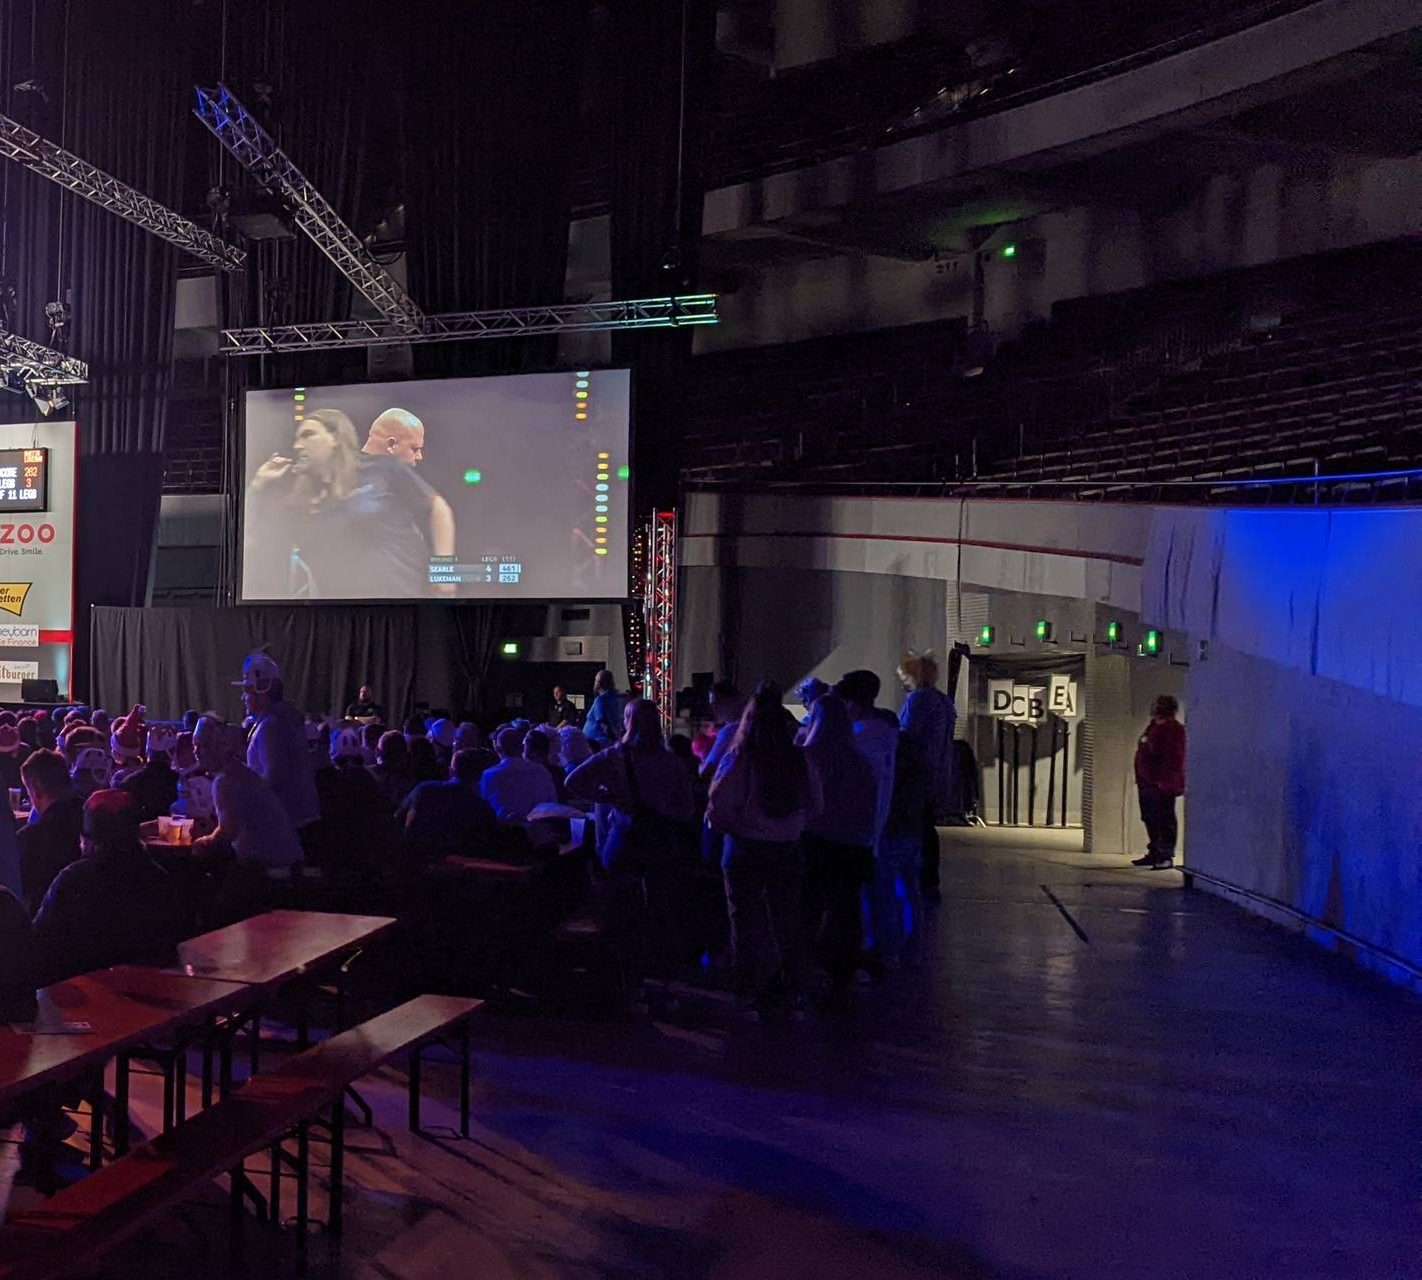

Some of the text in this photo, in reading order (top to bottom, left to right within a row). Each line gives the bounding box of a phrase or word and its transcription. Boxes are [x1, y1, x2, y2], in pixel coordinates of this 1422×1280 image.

[24, 467, 37, 477] 262
[26, 478, 31, 488] 3
[7, 489, 18, 500] 11
[994, 689, 1011, 711] D
[1054, 685, 1065, 706] E
[1013, 696, 1025, 717] C
[1030, 698, 1044, 718] B
